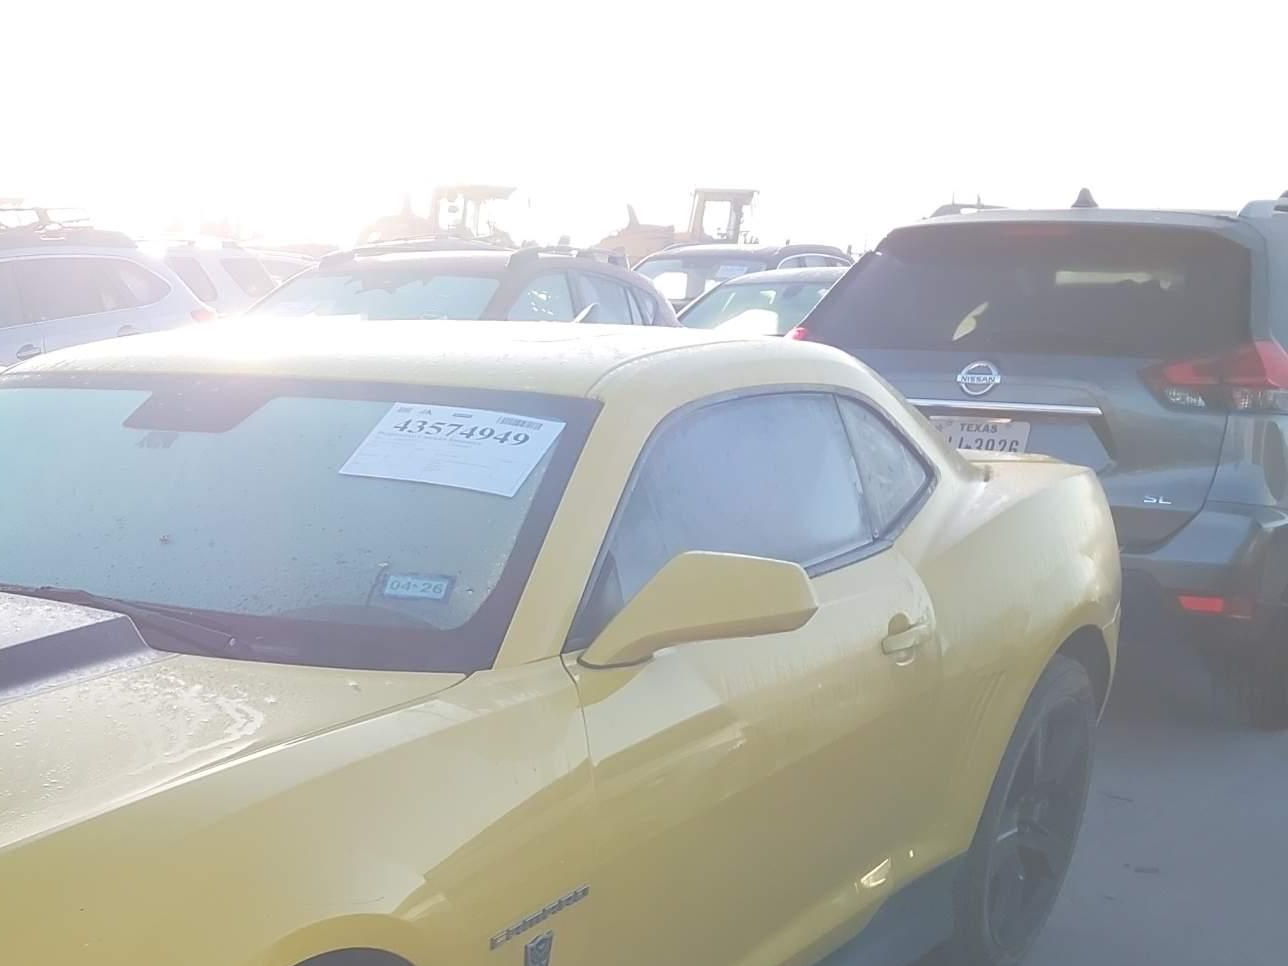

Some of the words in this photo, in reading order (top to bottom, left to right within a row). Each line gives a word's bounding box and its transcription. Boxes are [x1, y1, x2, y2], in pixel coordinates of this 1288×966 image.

[960, 374, 997, 384] NISSAN
[393, 418, 530, 446] 43574949
[959, 423, 998, 434] TEXAS
